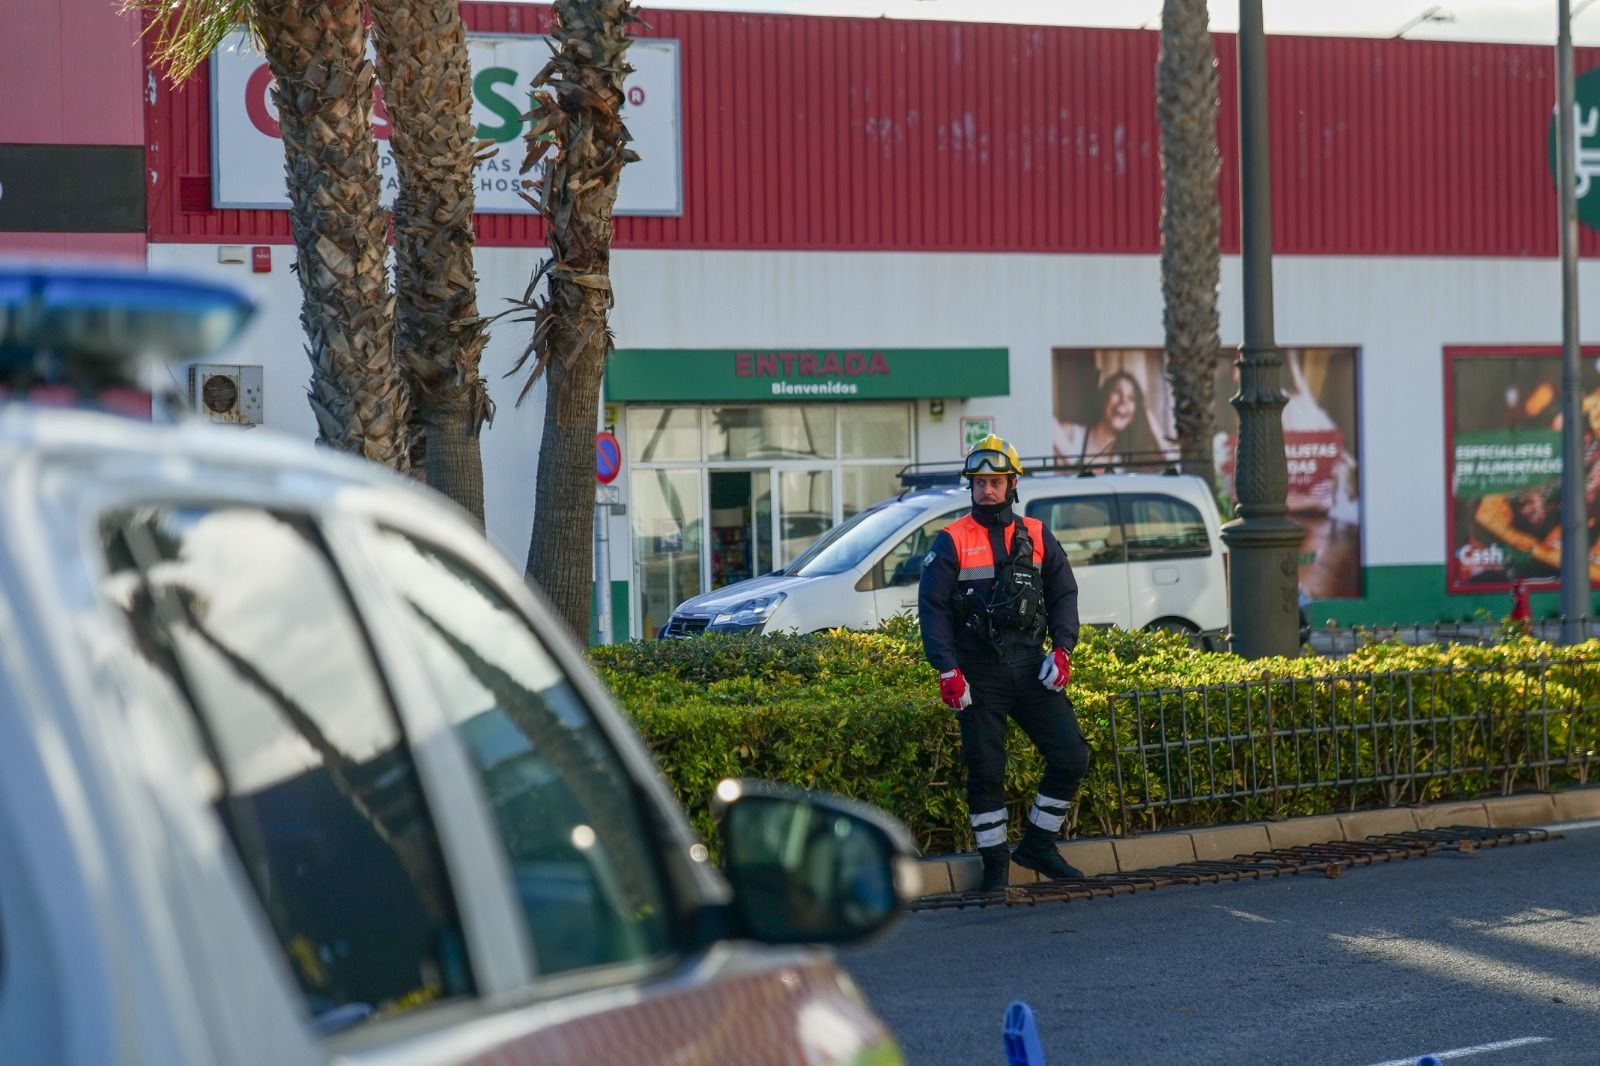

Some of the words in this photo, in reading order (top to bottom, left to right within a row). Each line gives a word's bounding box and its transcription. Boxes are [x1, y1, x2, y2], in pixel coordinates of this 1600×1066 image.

[735, 351, 889, 377] ENTRADA
[771, 380, 858, 395] Bienvenidos
[1455, 444, 1552, 459] ESPECIALISTAS
[1476, 456, 1563, 474] ALIMENTACIÓ
[1459, 543, 1503, 565] Cash
